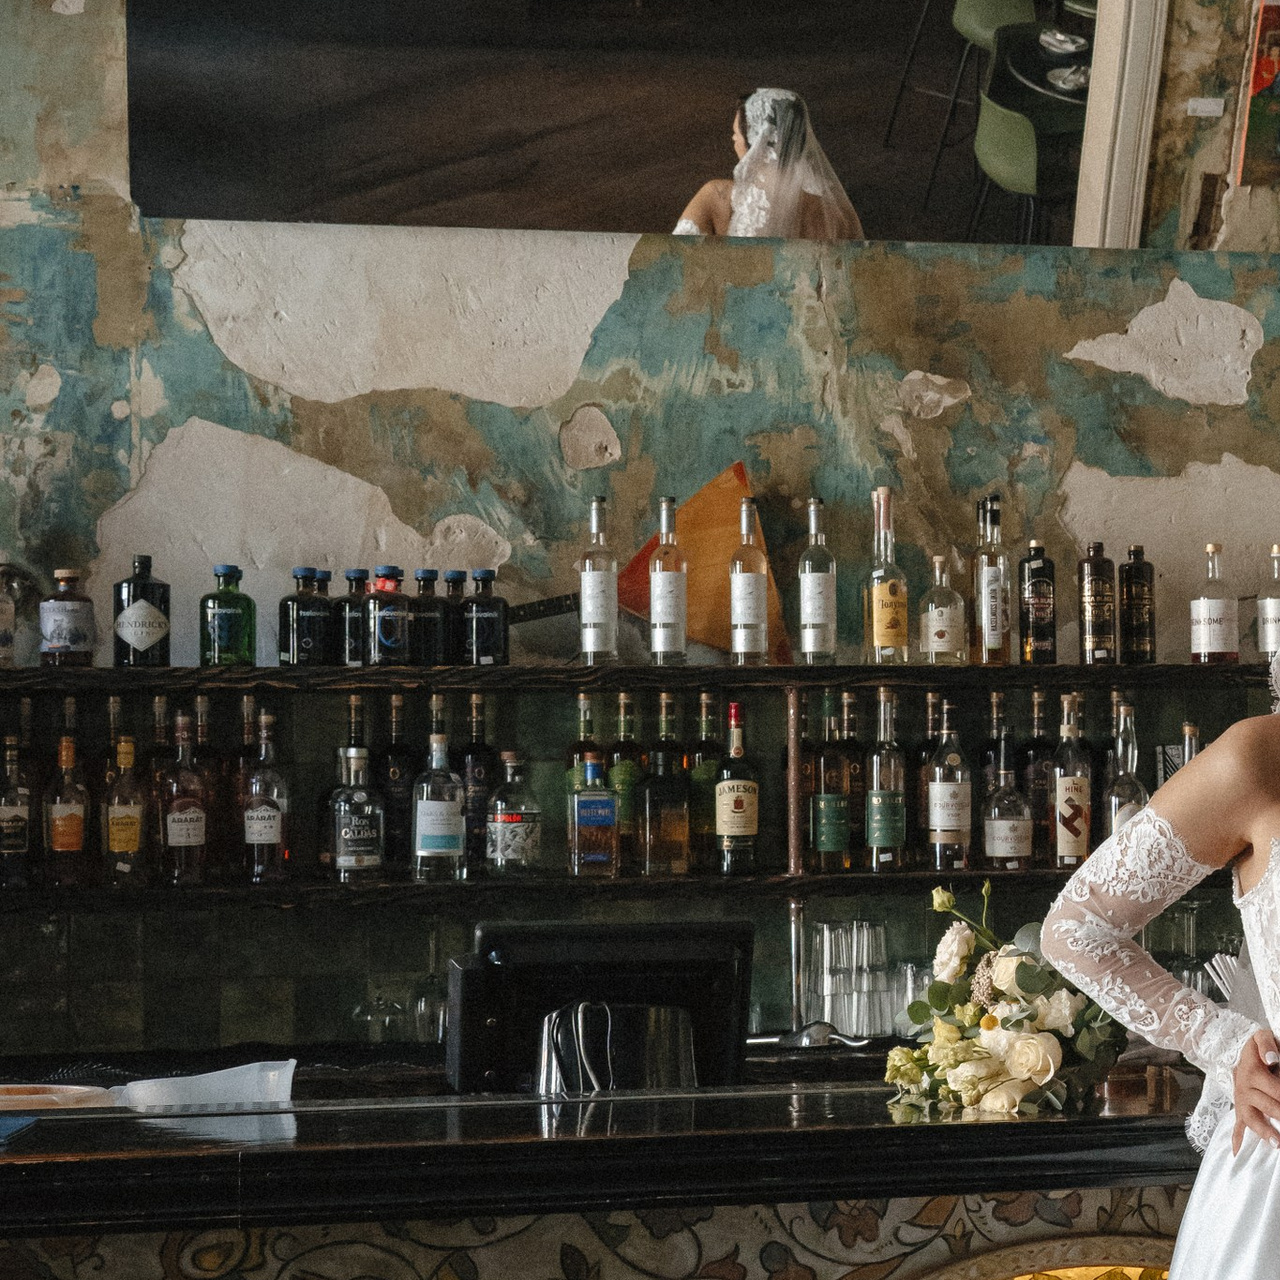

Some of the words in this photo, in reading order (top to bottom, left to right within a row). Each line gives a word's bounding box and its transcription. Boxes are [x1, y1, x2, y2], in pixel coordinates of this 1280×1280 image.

[718, 784, 757, 797] JAMESON
[1065, 785, 1082, 793] HINE
[171, 816, 203, 824] ARARAT
